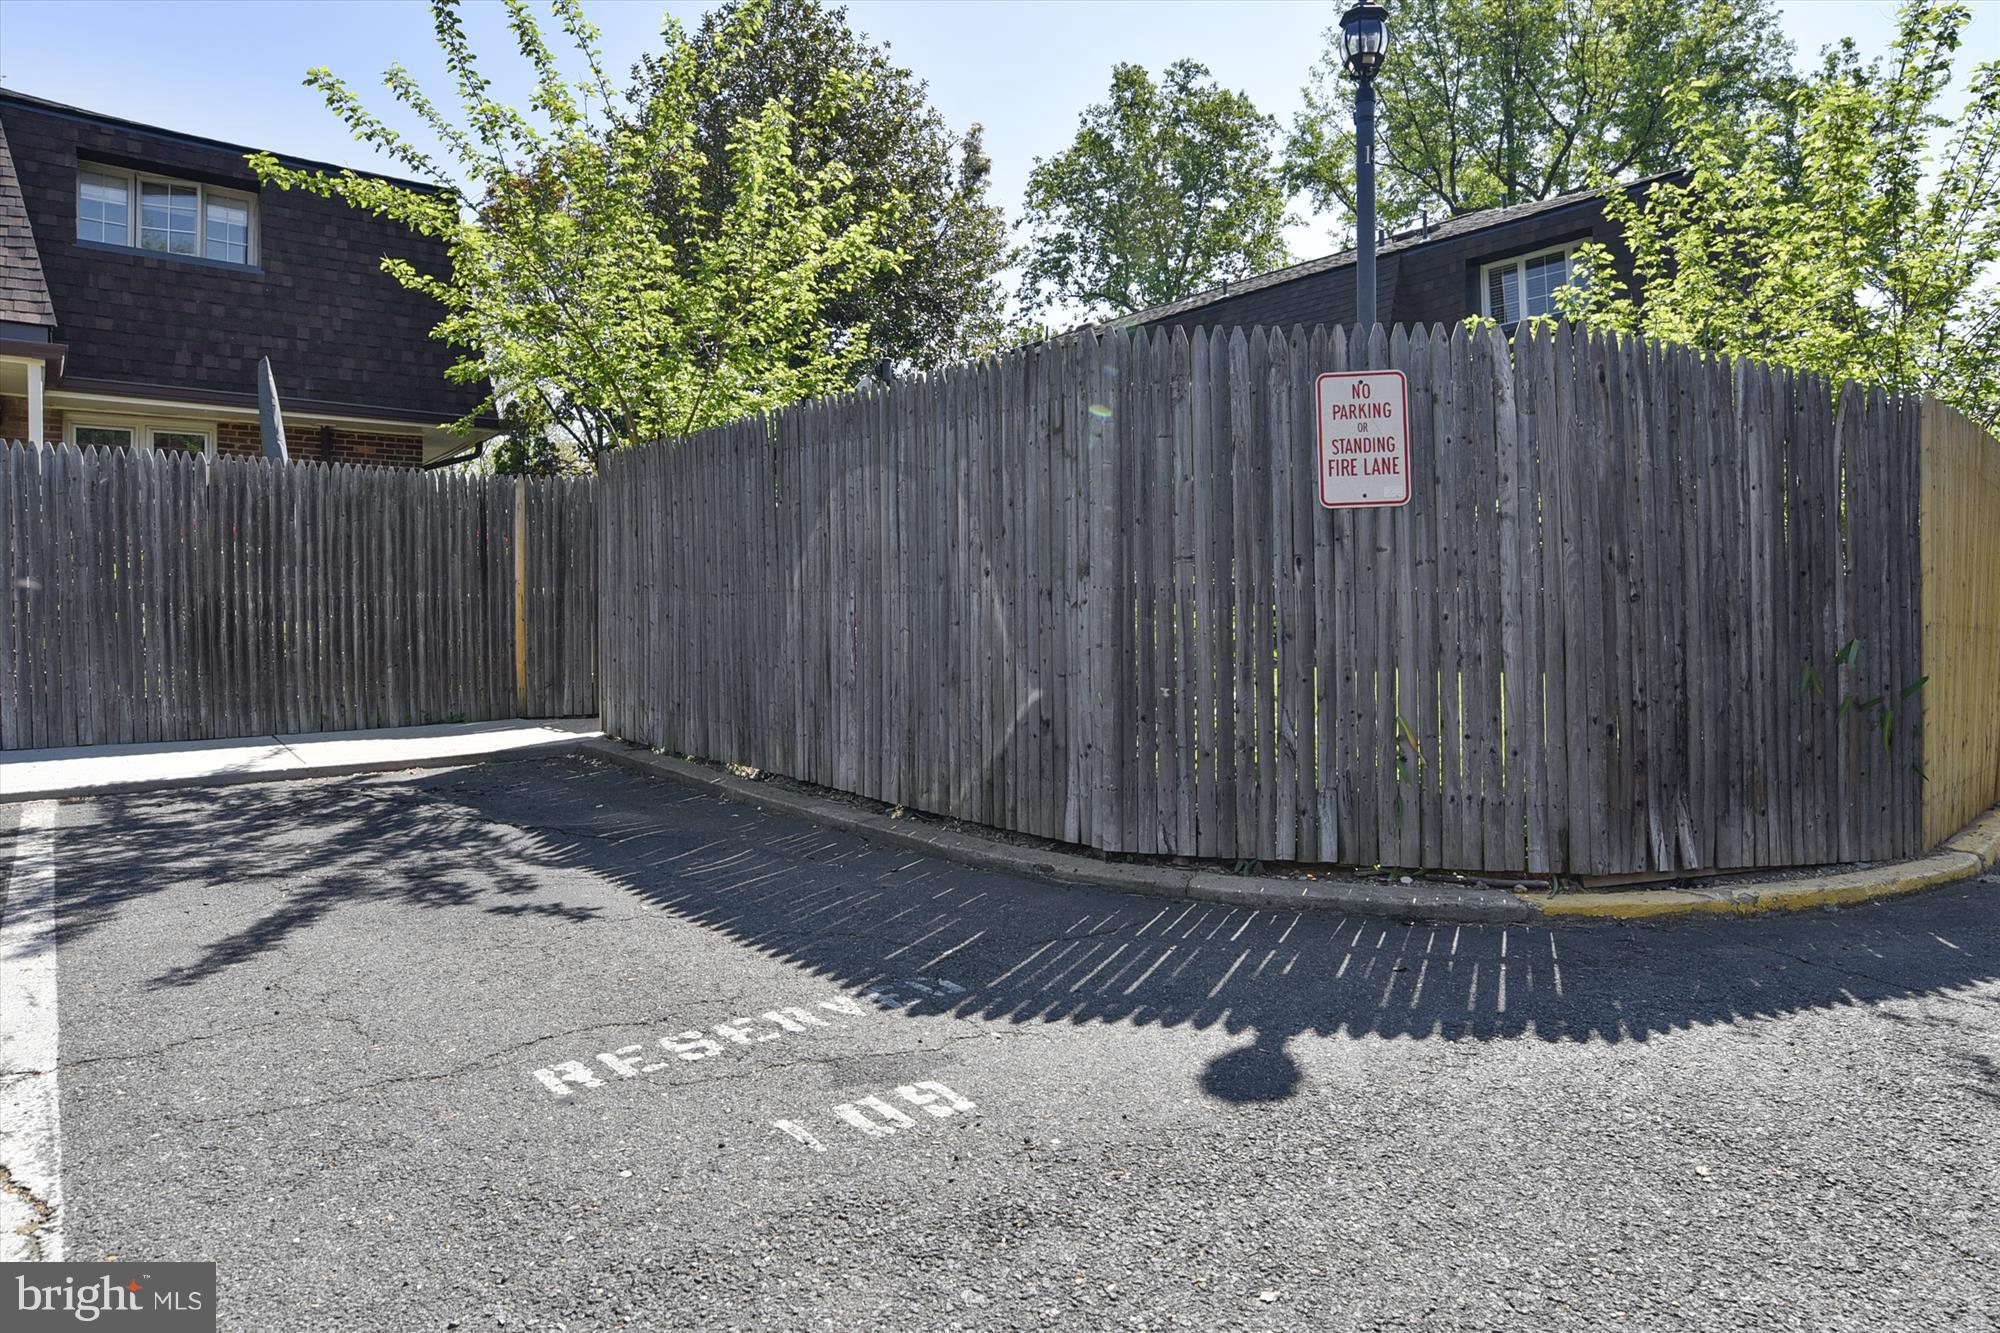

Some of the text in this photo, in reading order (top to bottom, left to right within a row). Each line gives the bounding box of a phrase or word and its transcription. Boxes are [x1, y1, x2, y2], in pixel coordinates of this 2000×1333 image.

[1352, 383, 1371, 399] NO
[1333, 402, 1392, 420] PARKING
[1357, 422, 1369, 433] OR
[1331, 436, 1396, 455] STANDING
[1328, 457, 1400, 477] FIRE LANE
[533, 977, 967, 1095] RESERVED
[774, 1080, 977, 1152] 109
